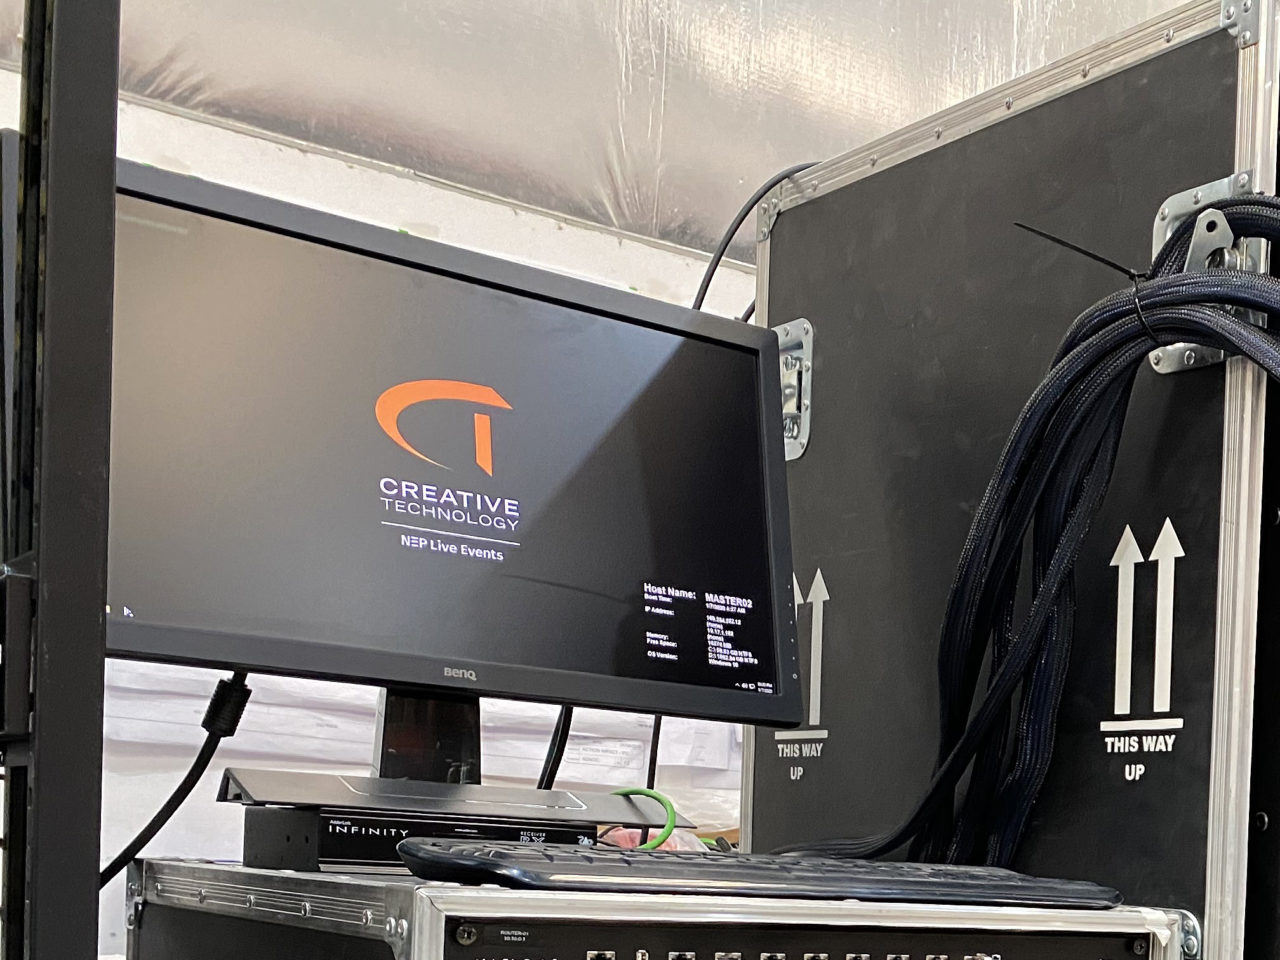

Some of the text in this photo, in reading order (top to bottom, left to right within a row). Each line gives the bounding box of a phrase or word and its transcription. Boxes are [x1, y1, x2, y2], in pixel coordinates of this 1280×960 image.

[380, 477, 520, 517] CREATIVE
[380, 497, 519, 531] TECHNOLOGY
[401, 534, 504, 561] NEP Live Events
[644, 582, 696, 599] Host Name:
[705, 592, 752, 608] MASTER02
[444, 666, 477, 680] BenQ
[777, 742, 824, 757] THIS WAY
[1105, 734, 1176, 753] THIS WAY
[790, 766, 804, 780] UP
[1124, 764, 1146, 782] UP
[328, 824, 409, 837] INFINITY
